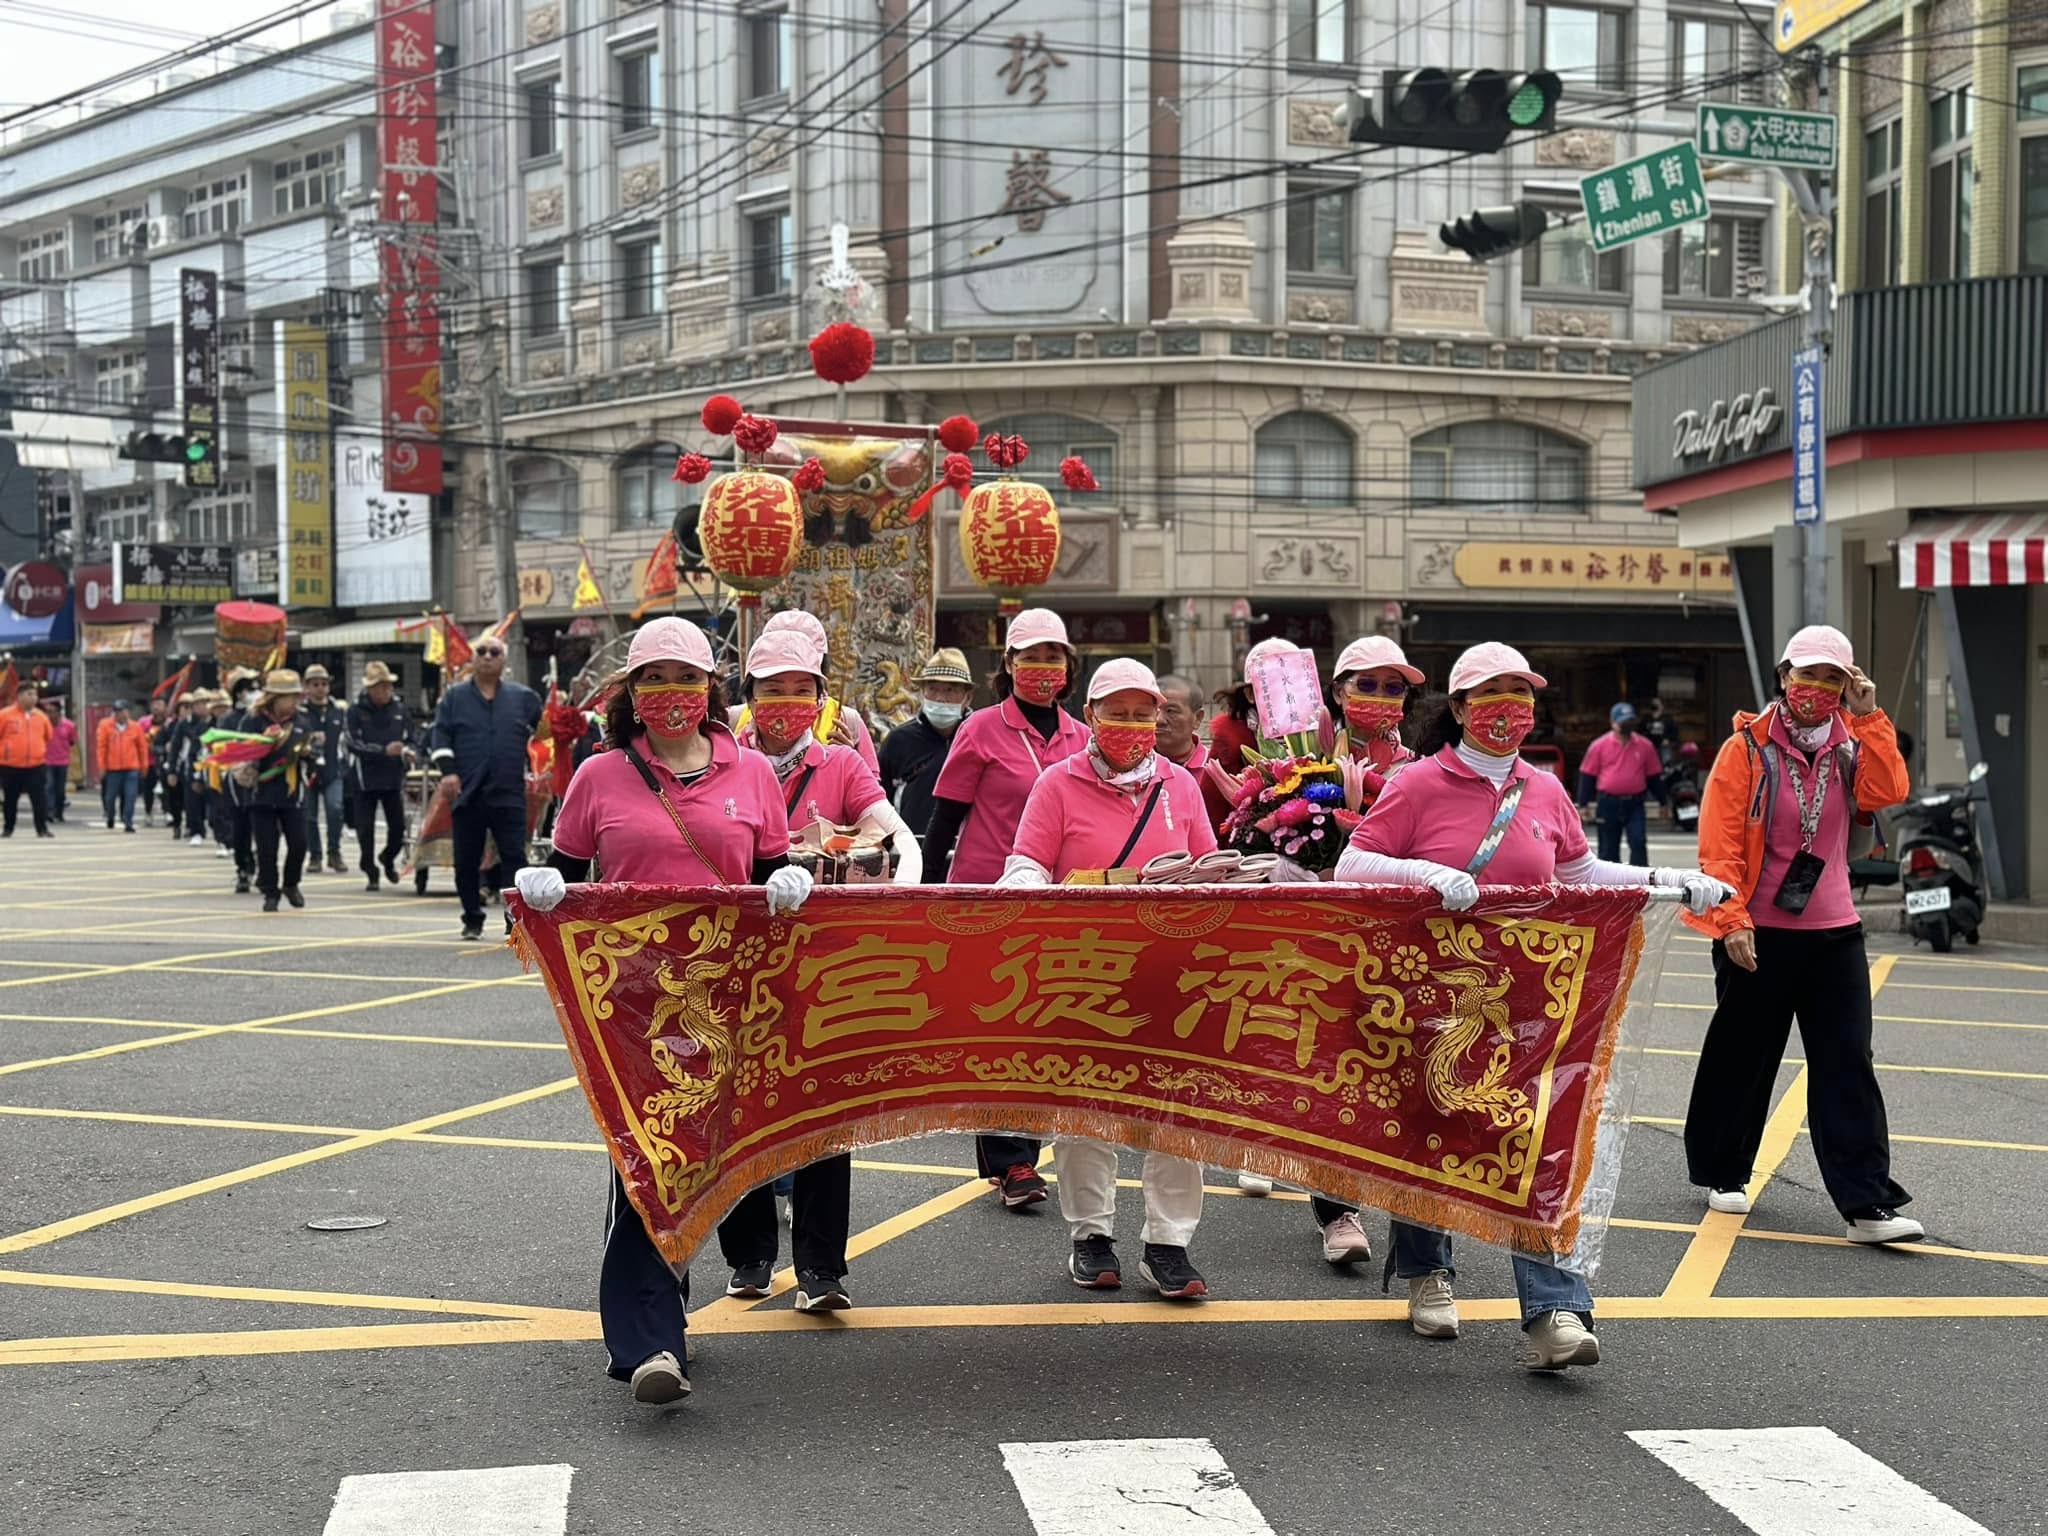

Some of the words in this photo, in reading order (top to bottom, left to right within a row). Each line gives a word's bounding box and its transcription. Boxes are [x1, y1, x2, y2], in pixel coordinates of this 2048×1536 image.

[1751, 116, 1832, 148] 大甲交流道
[1595, 155, 1684, 213] 鎮瀾街
[1603, 210, 1662, 240] Zhenlan
[1672, 400, 1726, 463] Daily
[1798, 368, 1816, 505] 公有停車場
